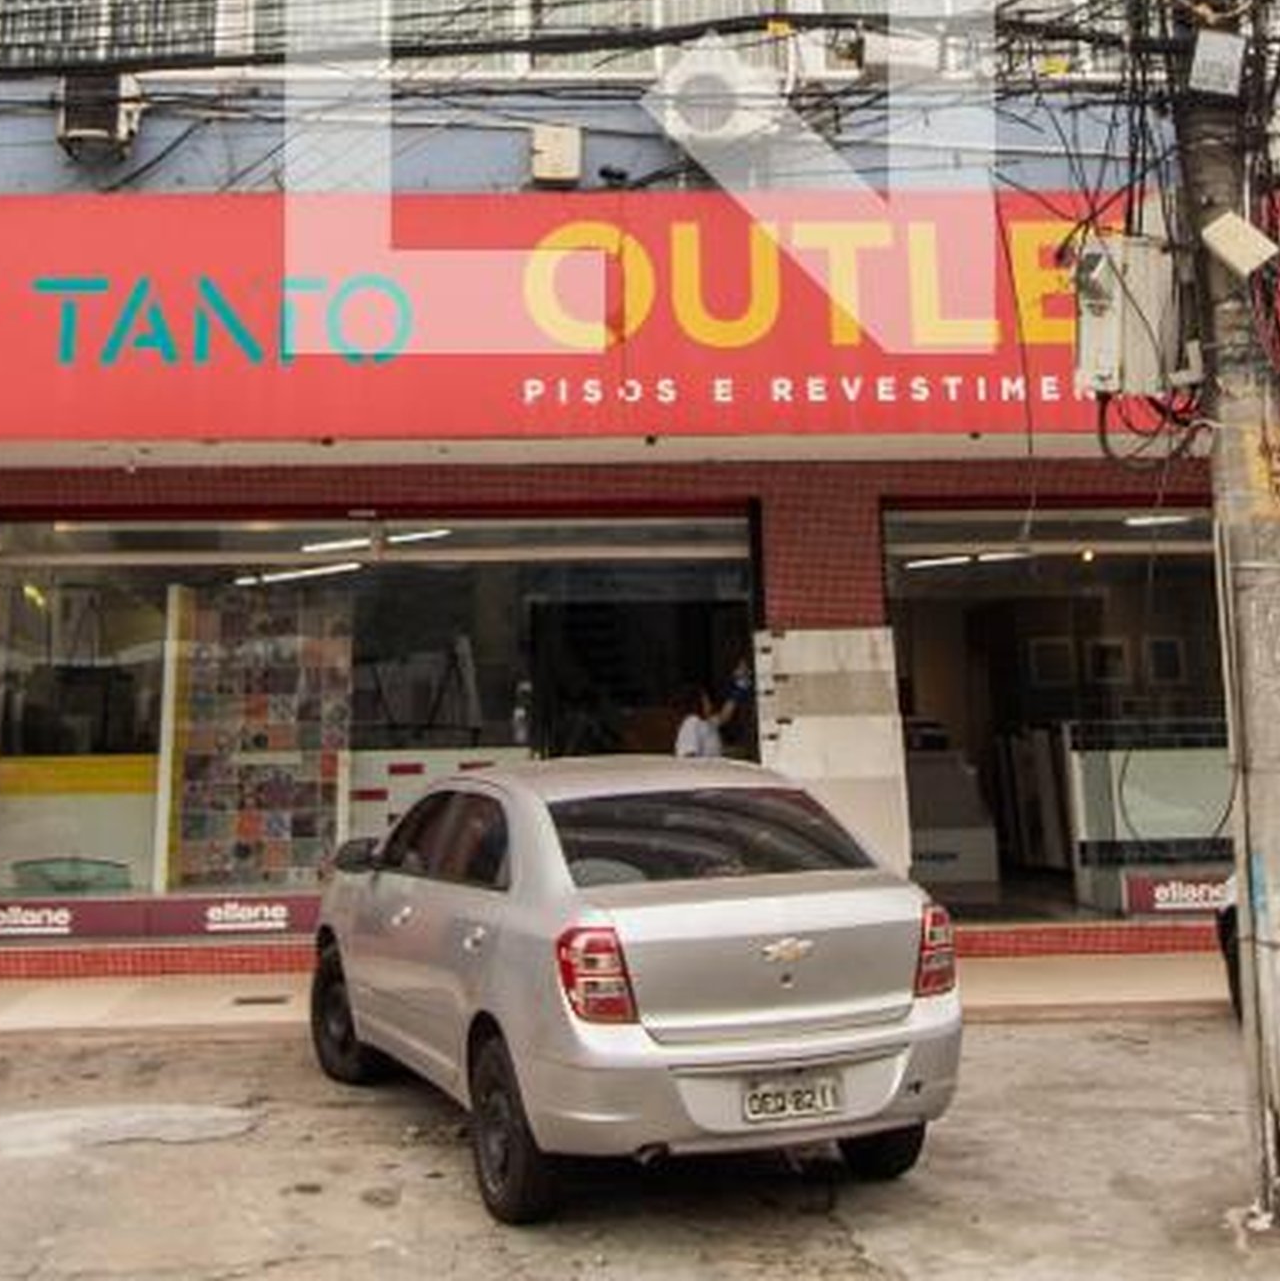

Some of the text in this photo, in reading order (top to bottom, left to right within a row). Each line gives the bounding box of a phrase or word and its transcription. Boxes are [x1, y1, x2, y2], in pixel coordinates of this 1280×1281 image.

[32, 274, 415, 366] TANTO
[524, 219, 1094, 349] OUTLE
[523, 376, 1095, 405] PISOS E REVESTIME
